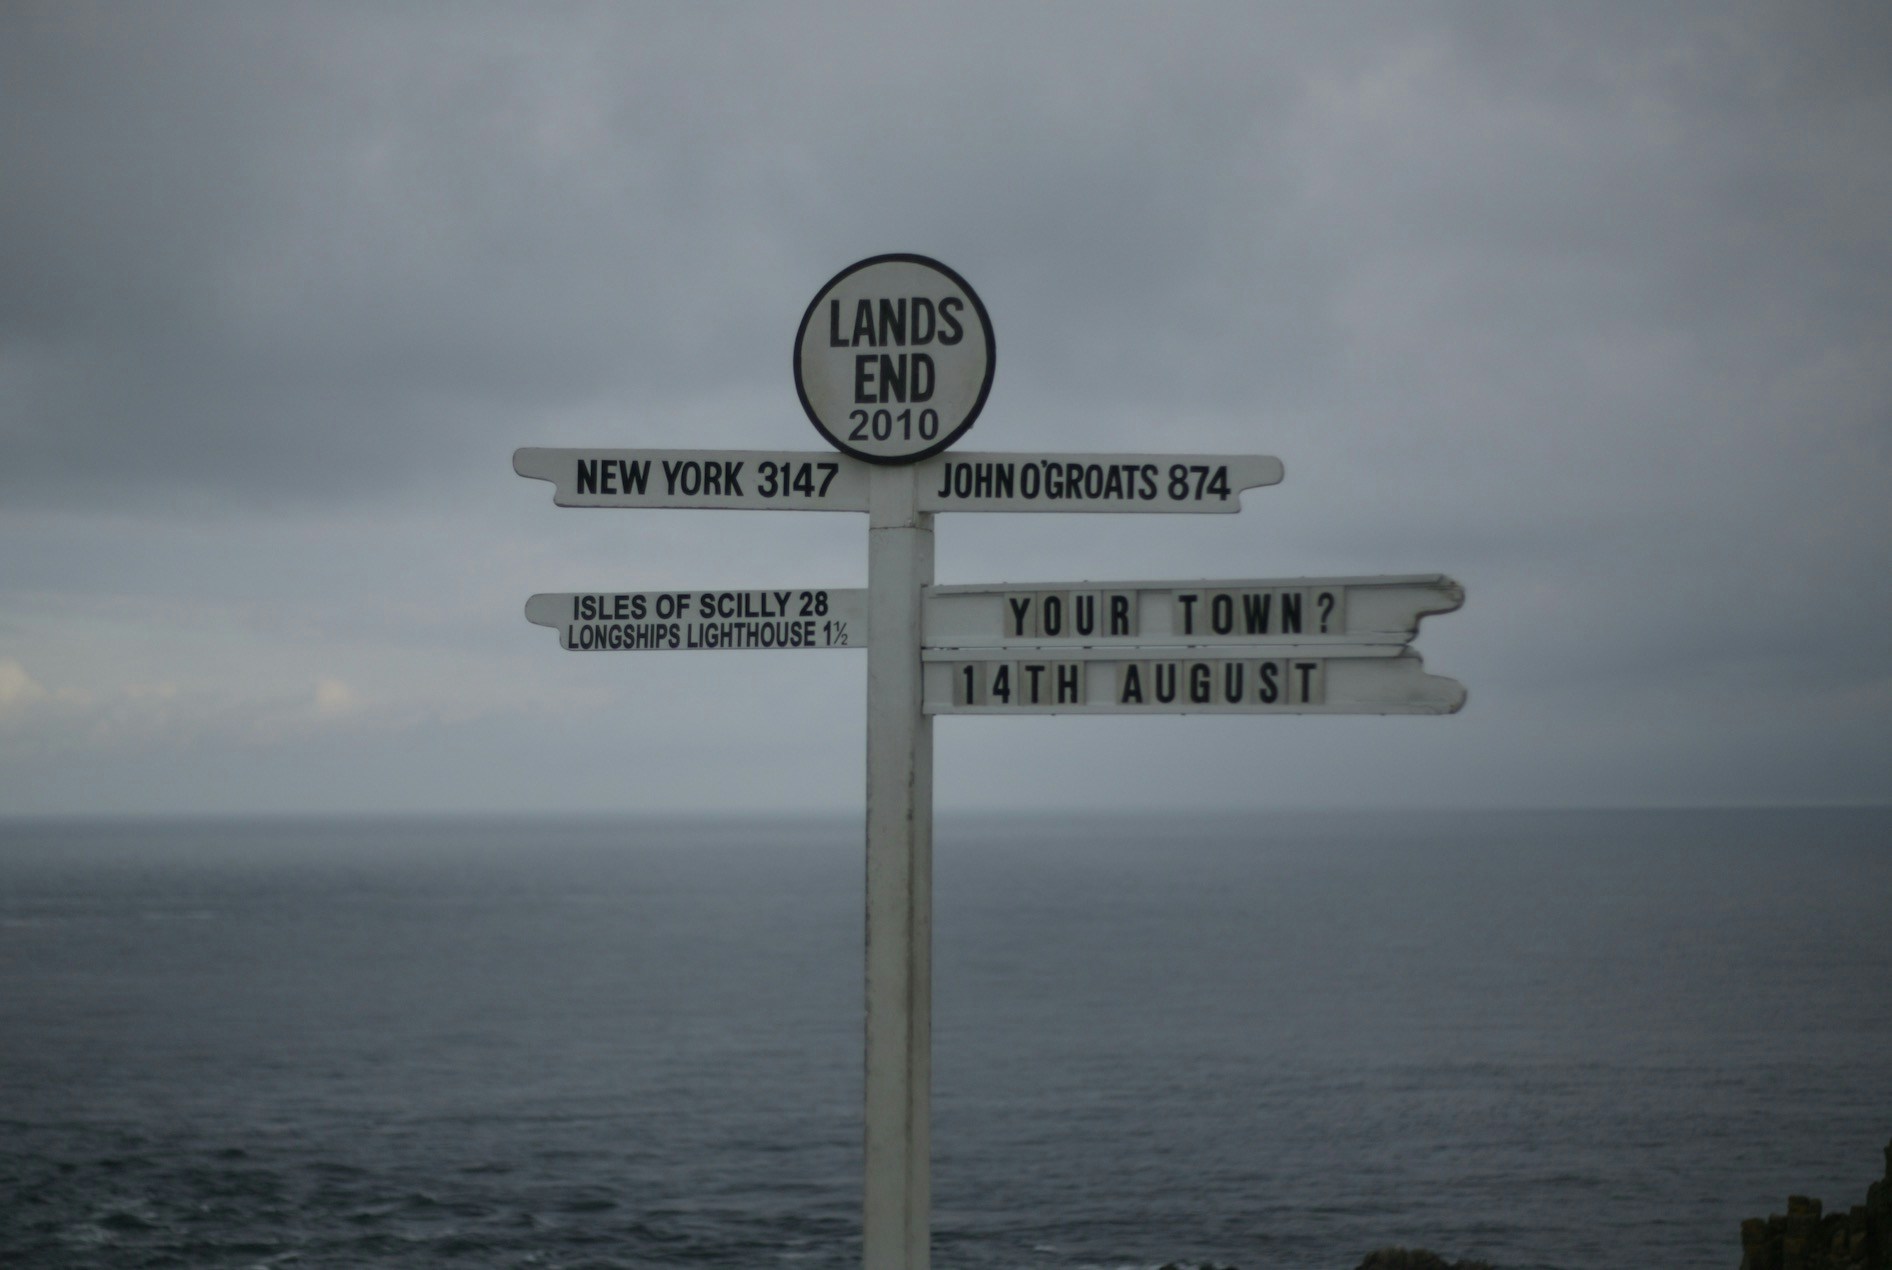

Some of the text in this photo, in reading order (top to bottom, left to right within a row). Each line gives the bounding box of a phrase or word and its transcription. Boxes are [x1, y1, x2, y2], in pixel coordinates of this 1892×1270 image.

[830, 297, 965, 348] LANDS
[854, 353, 936, 404] END
[848, 408, 939, 441] 2010
[576, 459, 839, 498] NEW YORK 3147
[937, 459, 1232, 501] JOHN O'GROATS 874
[573, 590, 829, 621] ISLES OF SCILLY 28
[1009, 591, 1336, 637] YOUR TOWN?
[568, 623, 680, 650] LONGSHIPS
[687, 620, 816, 648] LIGHTHOUSE
[961, 661, 1318, 704] 14TH AUGUST
